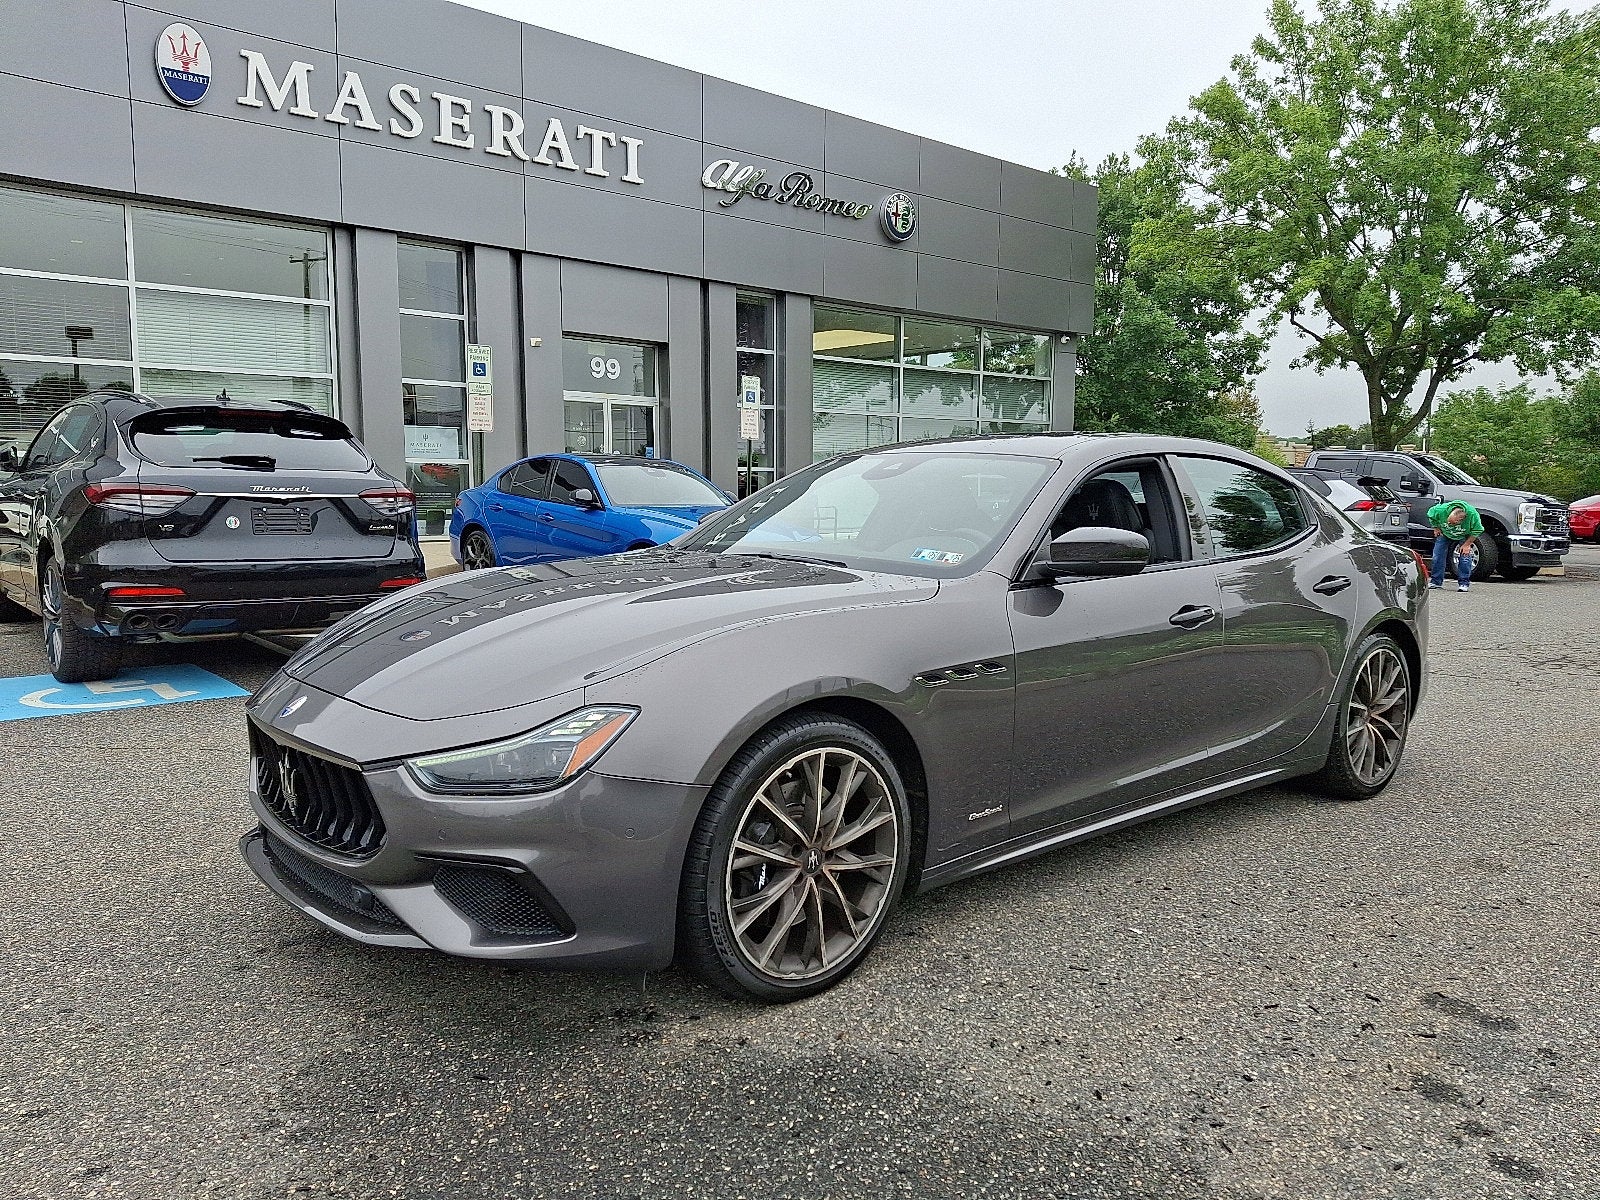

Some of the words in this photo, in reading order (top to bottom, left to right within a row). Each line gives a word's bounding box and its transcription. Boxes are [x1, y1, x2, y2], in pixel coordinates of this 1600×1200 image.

[164, 69, 208, 85] MASERATI
[237, 48, 645, 184] MASERATI
[701, 158, 778, 207] Alfa
[775, 171, 874, 220] Romeo
[590, 356, 621, 380] 99
[250, 485, 313, 493] Maserati
[709, 911, 729, 956] ZERO
